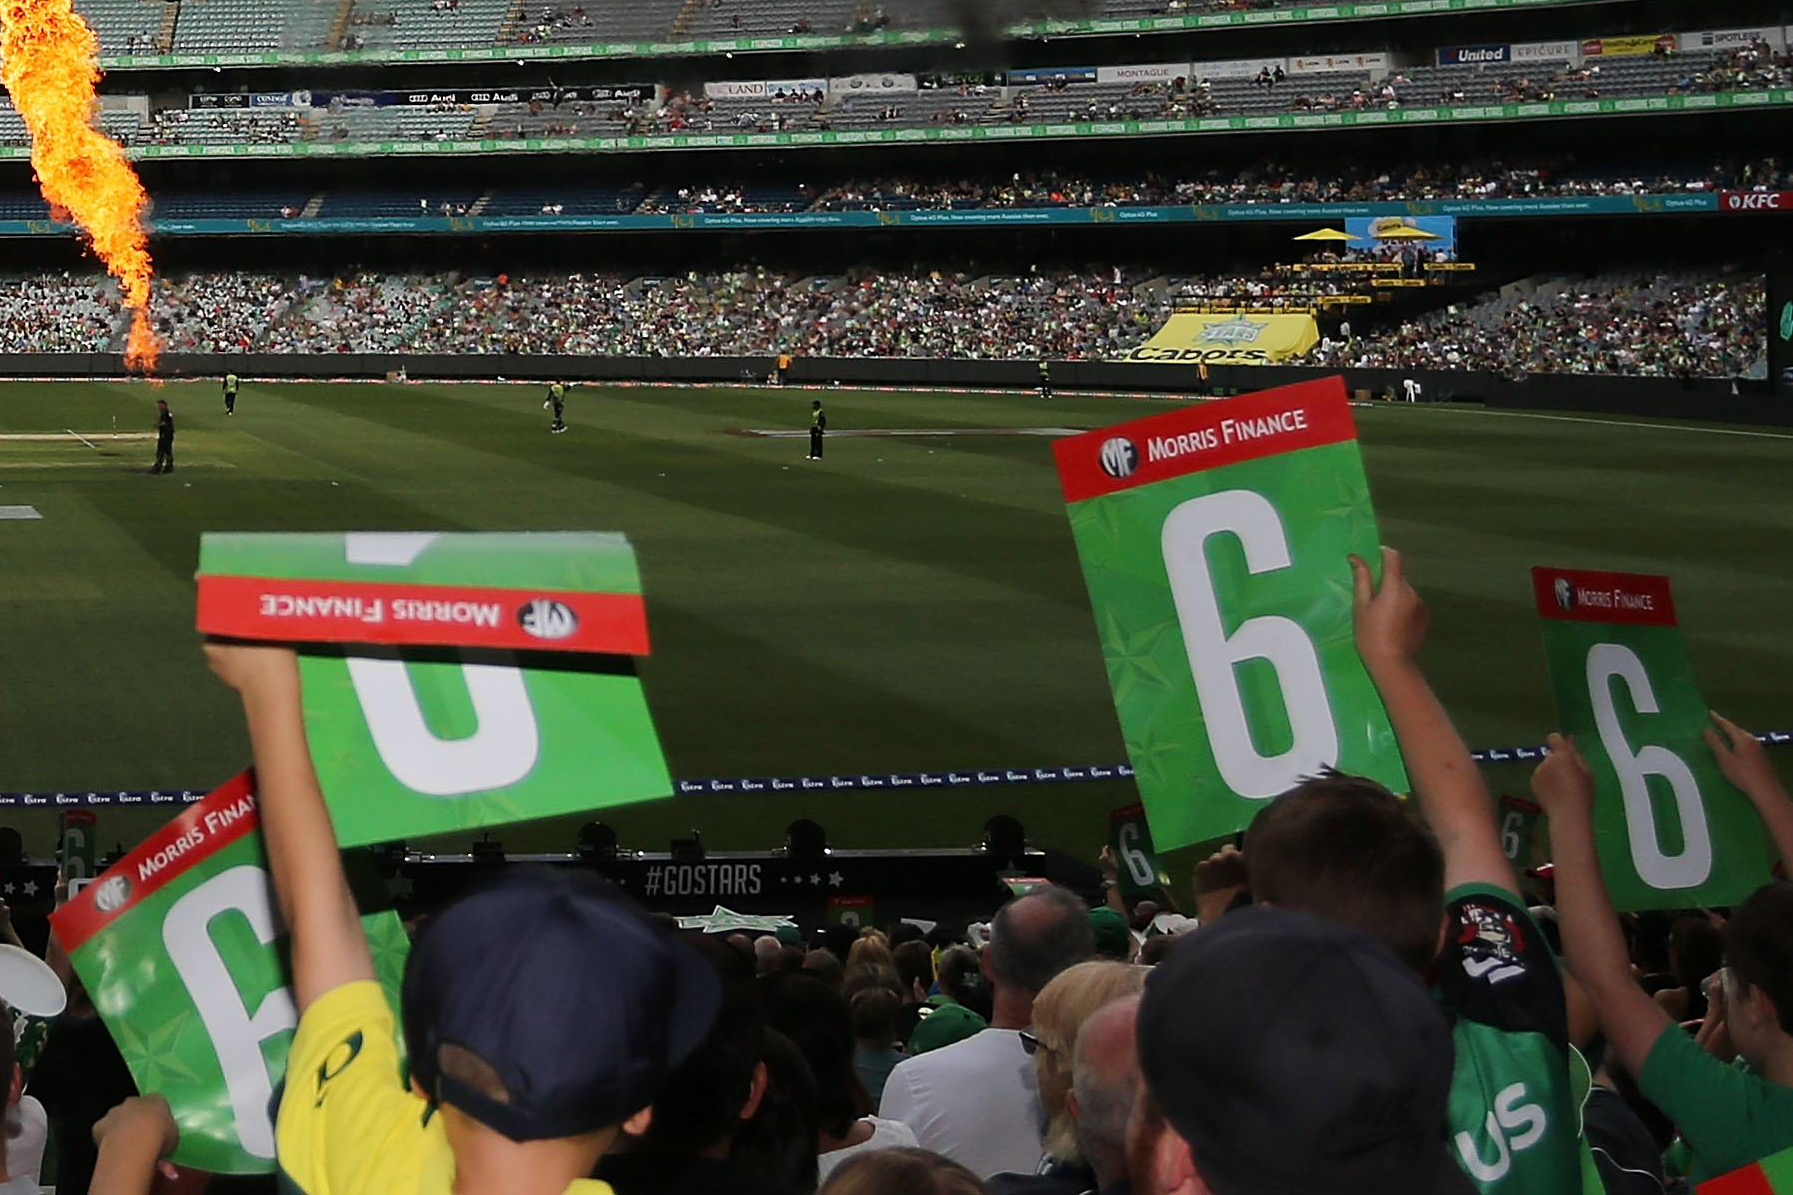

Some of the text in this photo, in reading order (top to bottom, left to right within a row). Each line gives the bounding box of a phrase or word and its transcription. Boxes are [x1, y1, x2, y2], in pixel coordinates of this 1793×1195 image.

[1714, 31, 1761, 43] SPOTLESS
[1458, 47, 1504, 63] United
[1517, 44, 1571, 57] EPICURE
[1116, 68, 1170, 79] MONTAGUE
[430, 94, 456, 104] Audi
[492, 93, 519, 102] Audi
[614, 89, 641, 98] Audi
[1741, 193, 1781, 209] KFC
[1146, 426, 1219, 463] MORRIS
[1220, 408, 1309, 446] FINANCE
[259, 593, 384, 623] FINANCE
[1576, 587, 1612, 608] MORRIS
[1613, 589, 1655, 611] FINANCE
[391, 599, 502, 628] MORRIS
[1160, 488, 1340, 801] 6
[1585, 642, 1713, 890] 6
[1501, 811, 1524, 860] 6
[138, 826, 205, 882] MORRIS
[1118, 821, 1156, 887] 6
[644, 864, 762, 896] #GOSTARS
